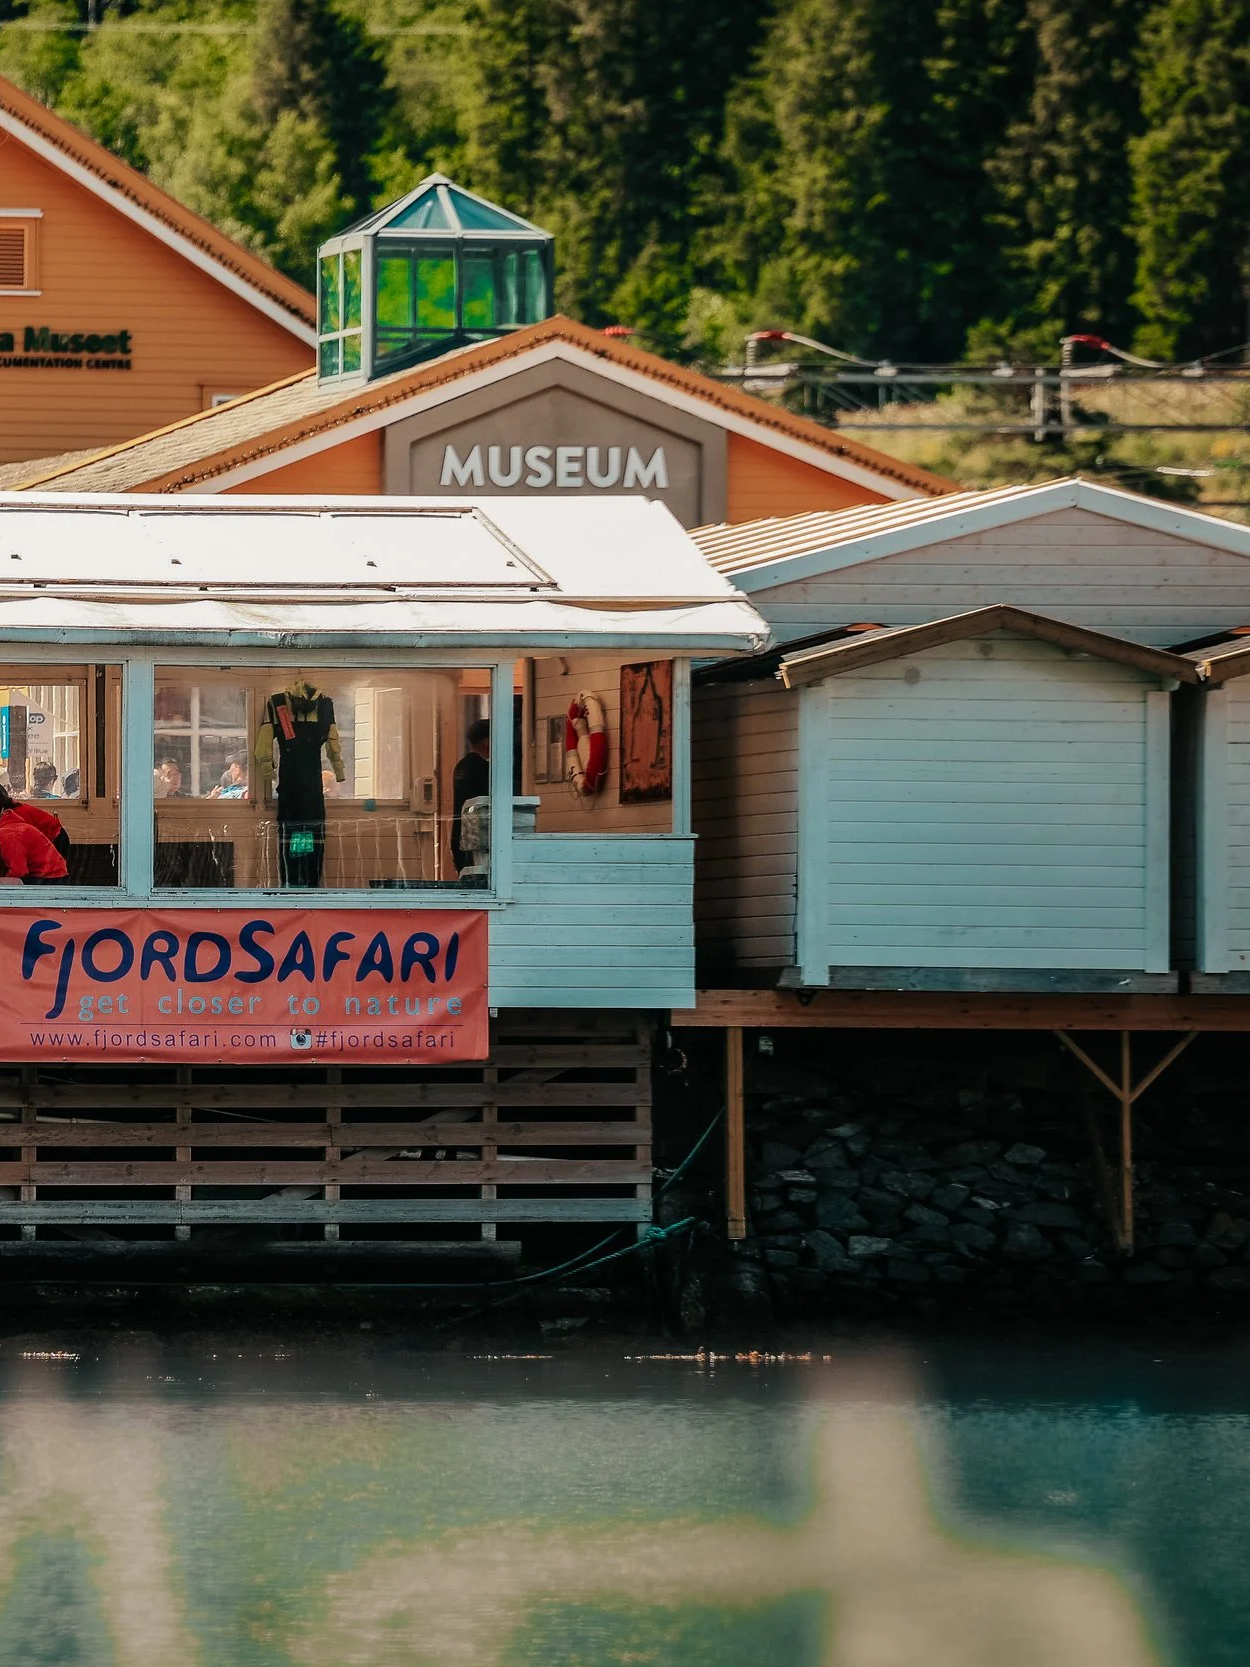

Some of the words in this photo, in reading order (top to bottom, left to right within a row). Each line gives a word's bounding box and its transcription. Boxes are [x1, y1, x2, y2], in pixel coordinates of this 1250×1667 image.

[24, 326, 133, 354] Museet
[86, 358, 133, 370] CENTRE
[439, 444, 669, 488] MUSEUM
[77, 993, 130, 1022] get
[157, 988, 262, 1015] closer
[287, 994, 321, 1015] to
[344, 995, 463, 1015] nature
[30, 1029, 277, 1050] www.fjordsafari.com
[315, 1030, 454, 1051] #fjordsafari
